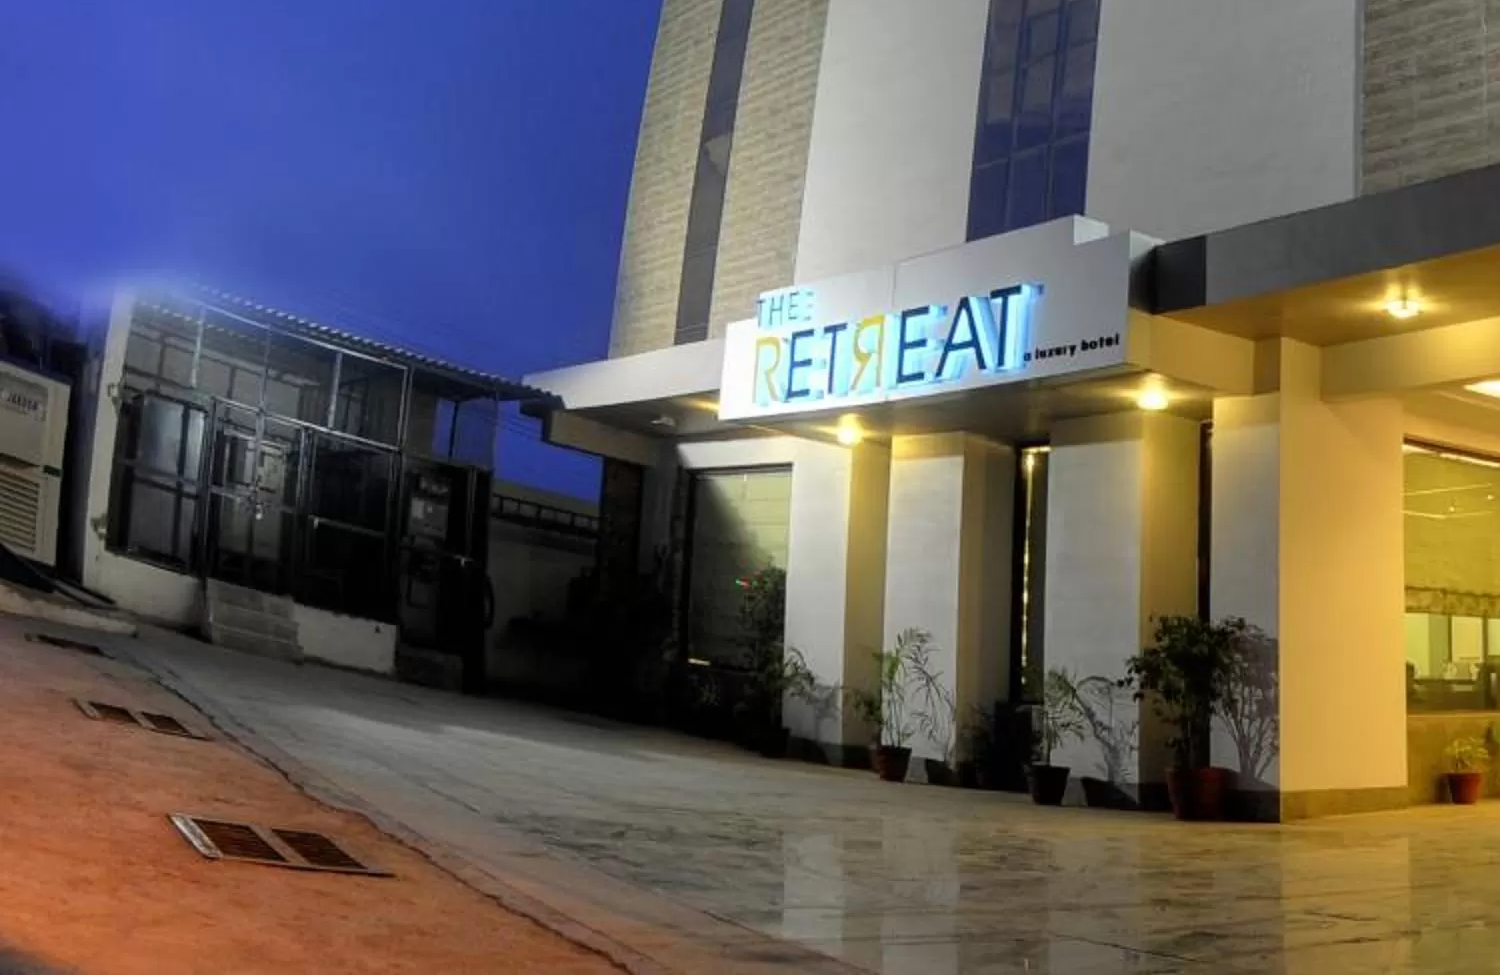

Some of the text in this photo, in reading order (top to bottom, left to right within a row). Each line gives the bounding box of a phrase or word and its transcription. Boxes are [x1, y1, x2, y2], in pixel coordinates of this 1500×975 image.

[754, 290, 804, 328] THE
[752, 284, 1028, 404] RETREAT
[1034, 345, 1077, 360] luxury
[1081, 333, 1120, 351] hotel
